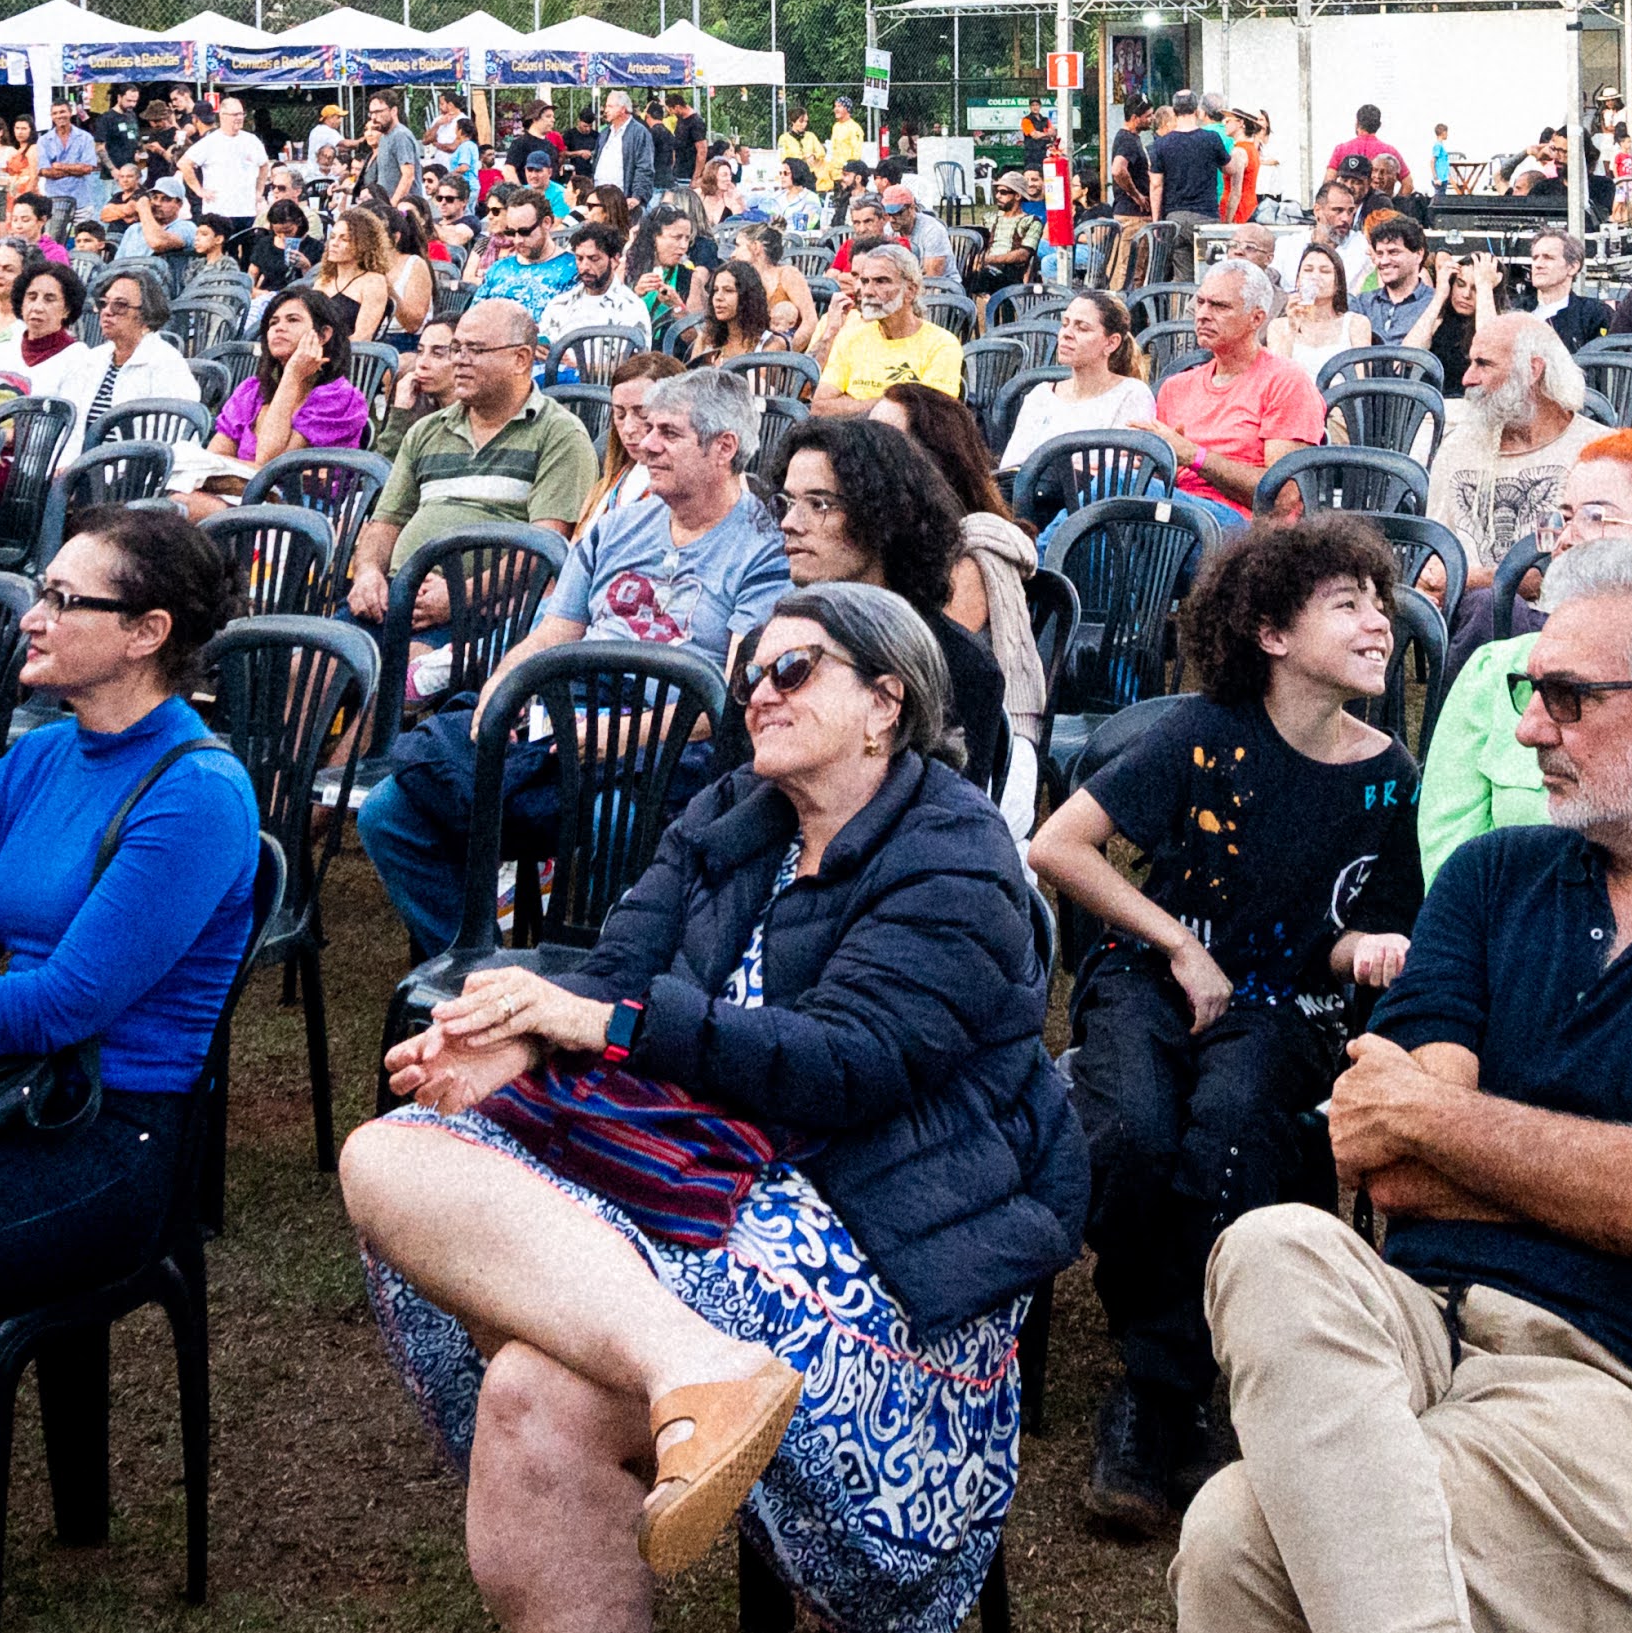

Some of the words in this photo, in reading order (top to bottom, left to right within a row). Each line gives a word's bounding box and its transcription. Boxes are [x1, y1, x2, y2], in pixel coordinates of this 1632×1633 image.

[88, 54, 133, 68] Comidas
[134, 57, 141, 67] e
[141, 52, 179, 67] Bebidas
[231, 57, 272, 69] Comidas
[273, 59, 280, 68] e
[281, 56, 321, 68] Bebidas
[369, 58, 410, 71] Comidas
[411, 61, 418, 70] e
[419, 57, 452, 70] Bebidas
[627, 62, 671, 75] Artesanatos
[987, 98, 1017, 106] COLETA
